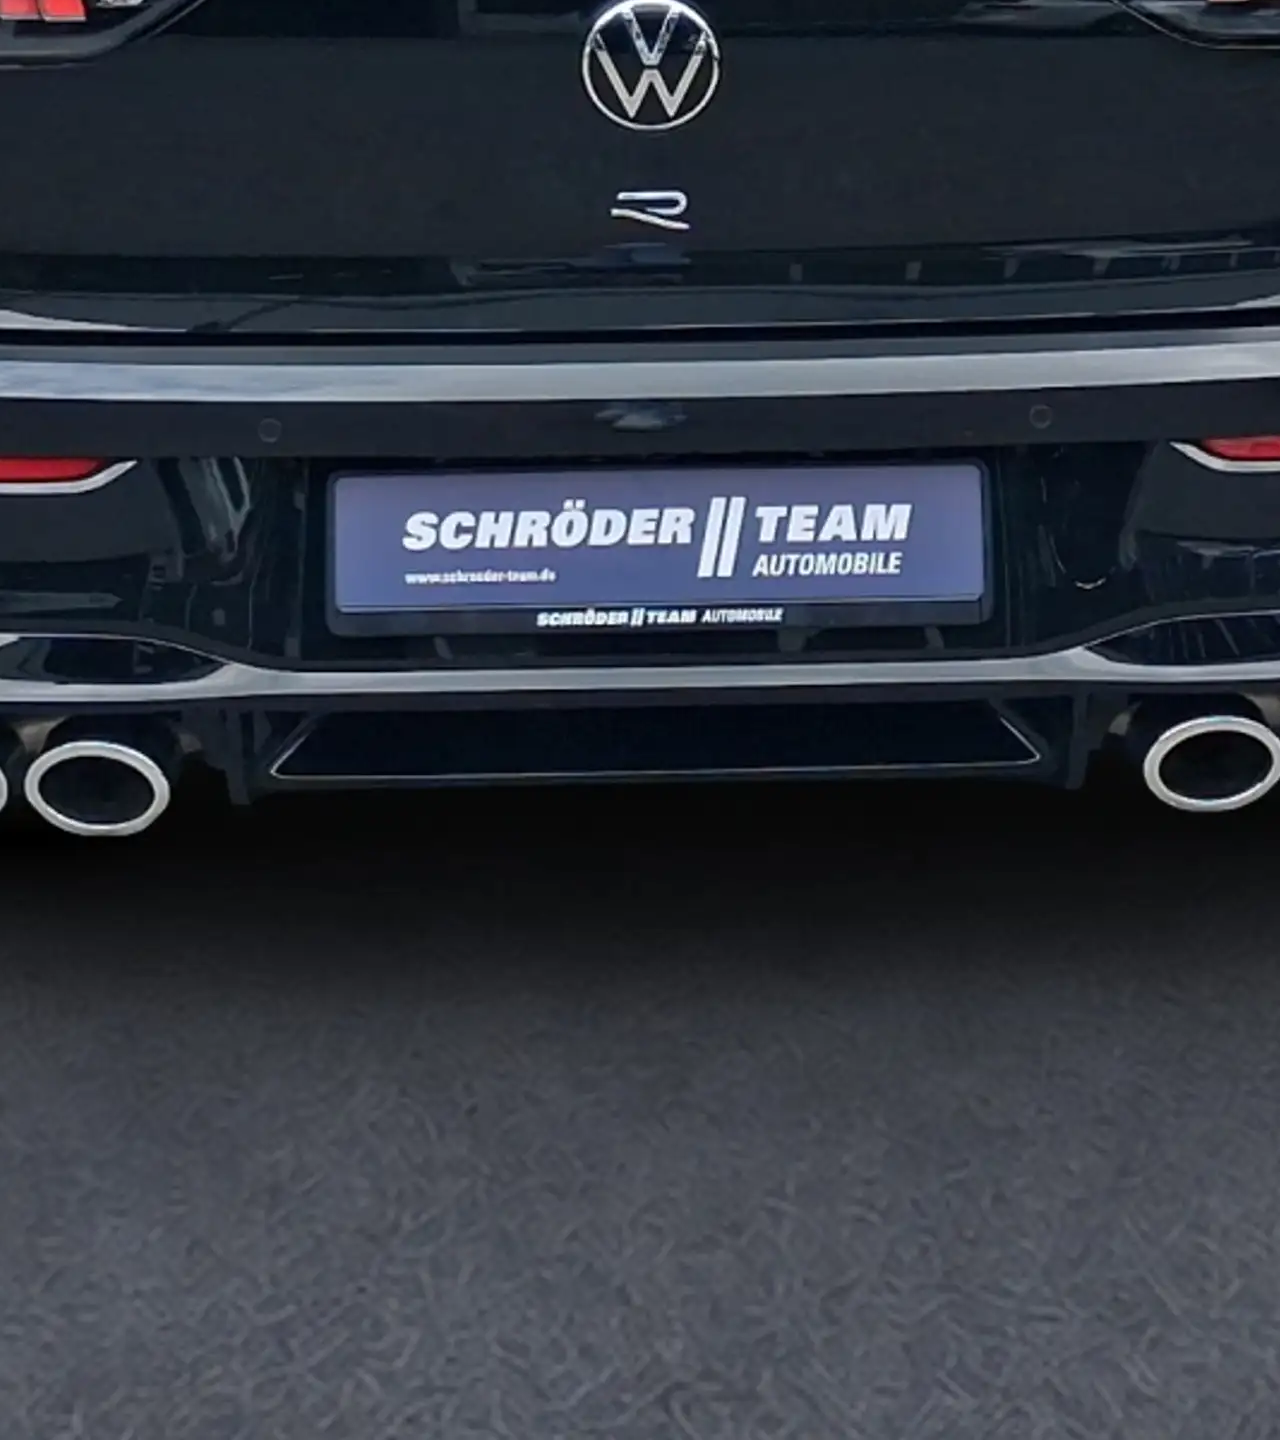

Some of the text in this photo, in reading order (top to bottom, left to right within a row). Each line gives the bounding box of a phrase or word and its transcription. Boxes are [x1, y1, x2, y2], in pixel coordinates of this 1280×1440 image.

[402, 499, 912, 551] SCHRÖDER TEAM
[751, 551, 903, 577] AUTOMOBILE
[536, 608, 784, 627] SCHRÖDER TEAM AUTOMOBILE
